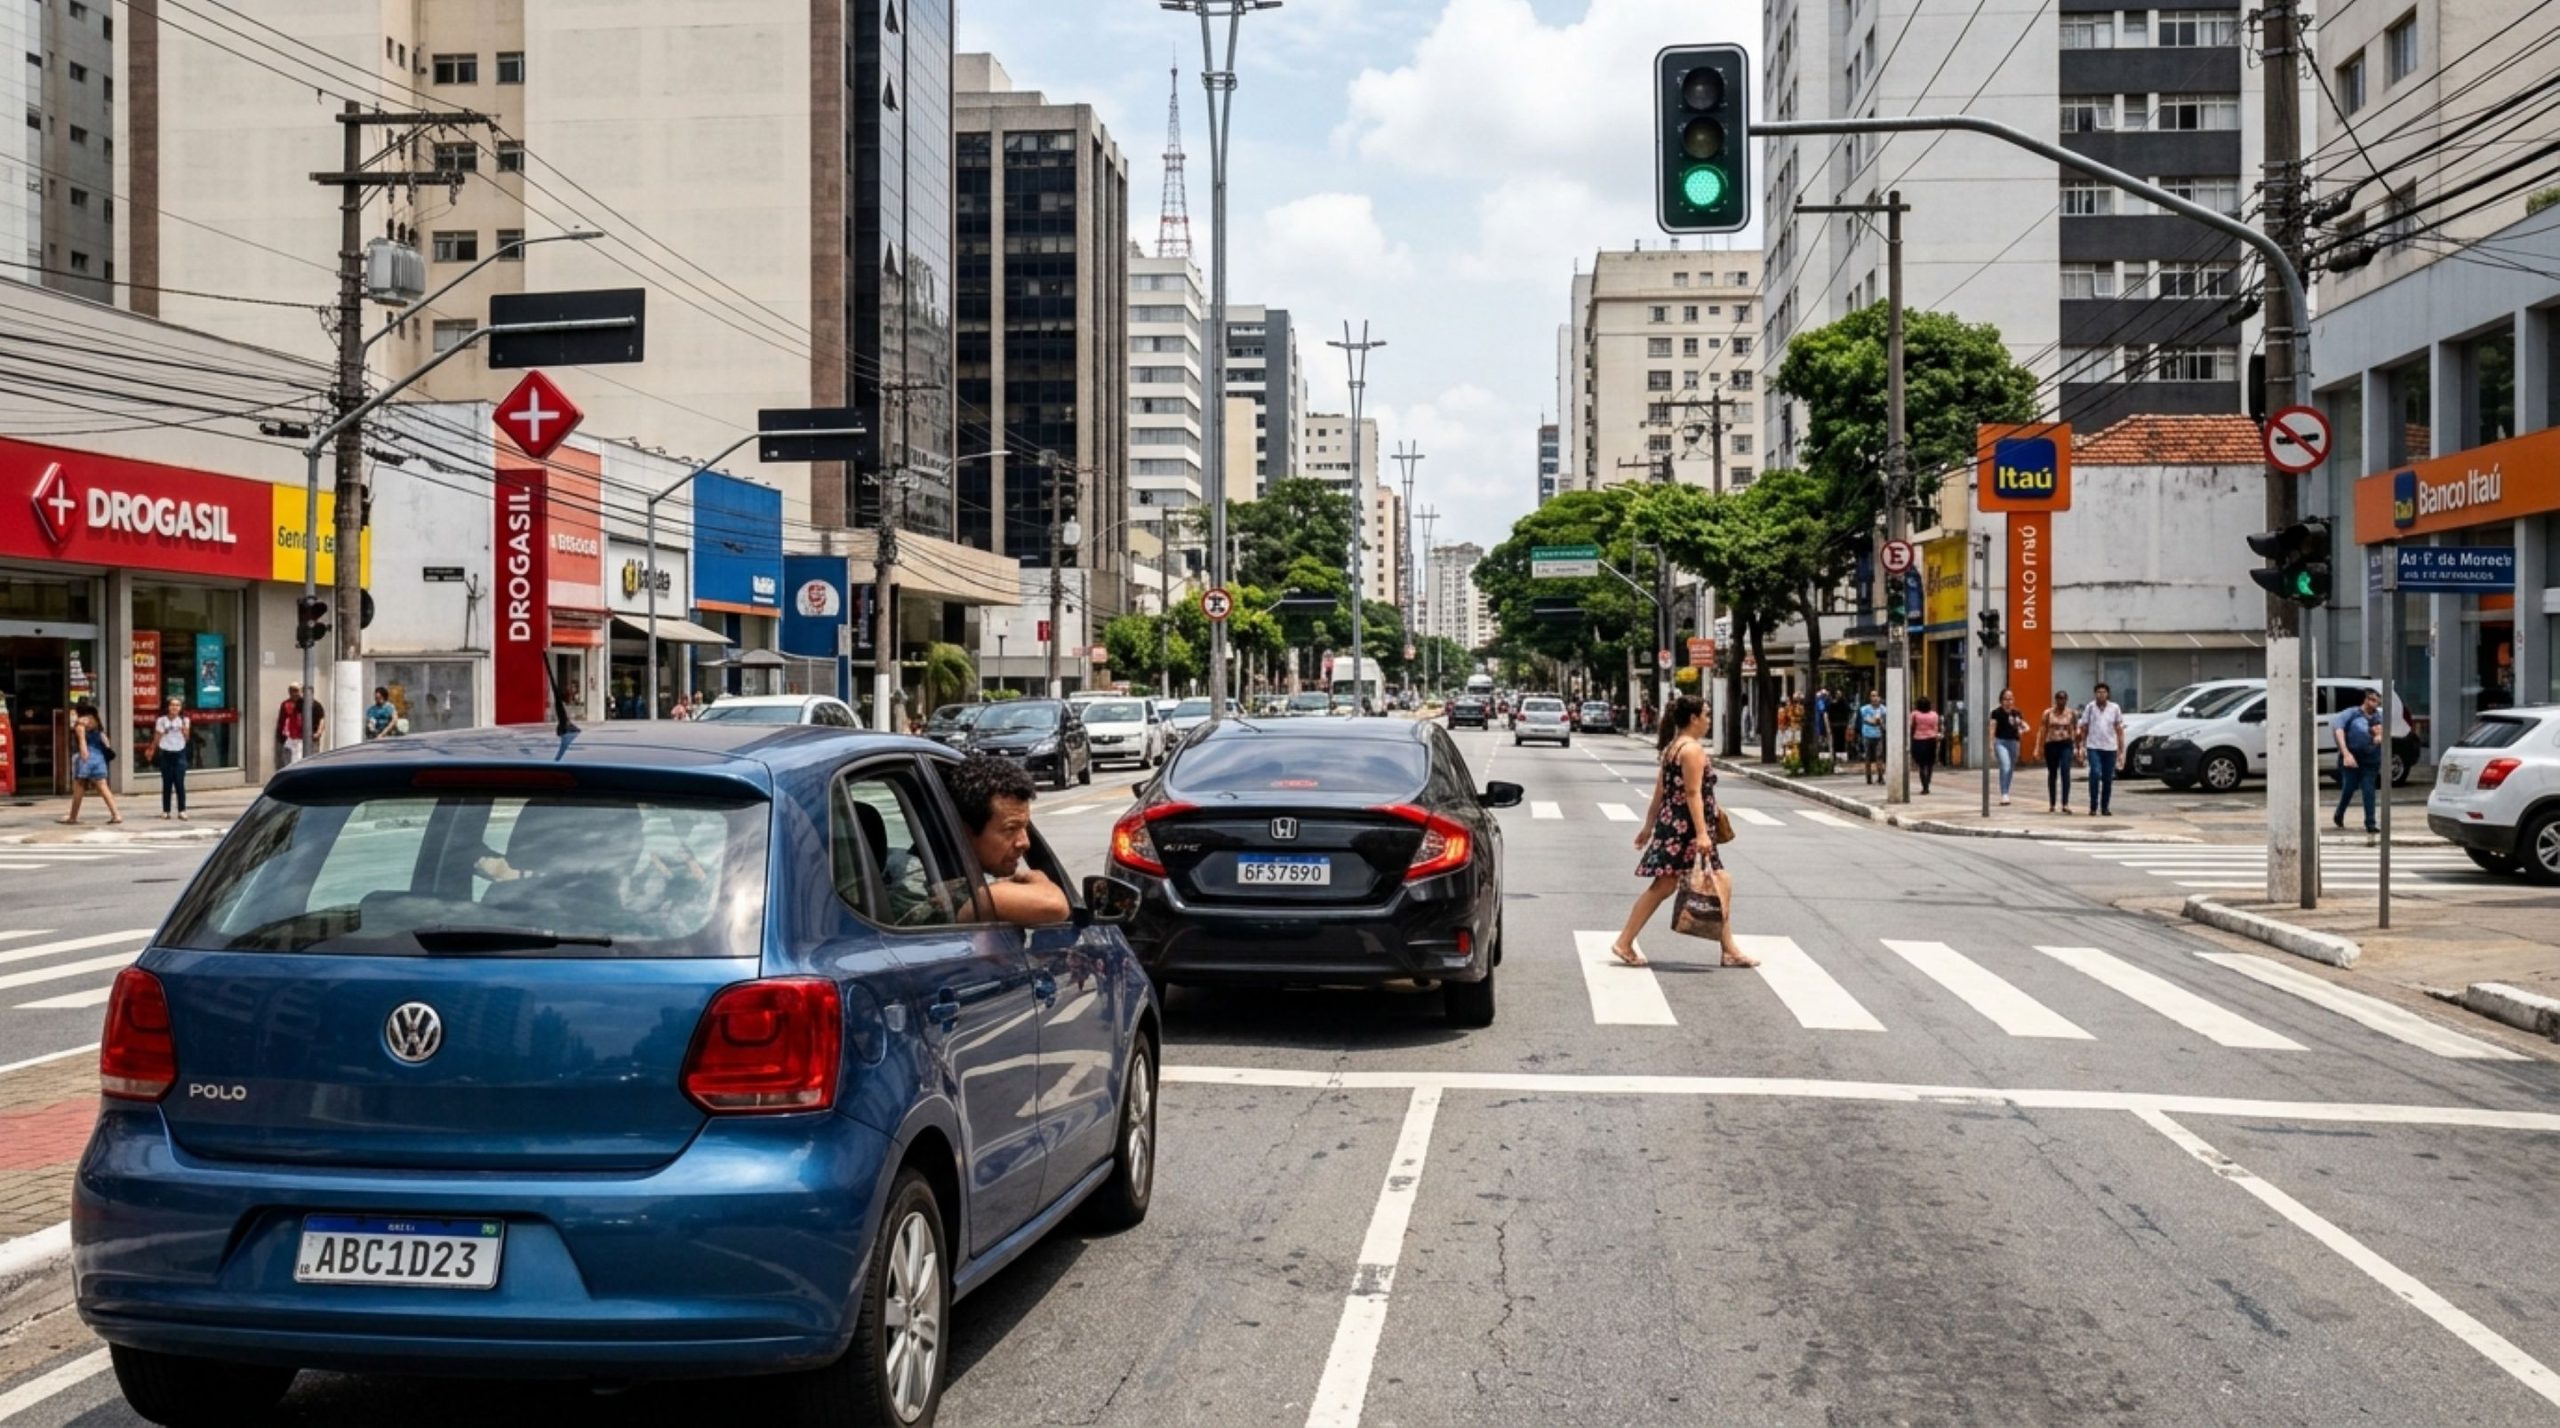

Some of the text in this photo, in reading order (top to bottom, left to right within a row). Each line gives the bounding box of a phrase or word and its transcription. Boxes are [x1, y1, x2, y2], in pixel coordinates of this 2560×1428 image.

[1998, 466, 2053, 489] Itaú
[2418, 463, 2502, 515] Banco Itaú
[87, 487, 237, 544] DROGASIL
[1889, 546, 1905, 566] E
[188, 1083, 247, 1101] POLO
[315, 1236, 478, 1280] ABC1D23
